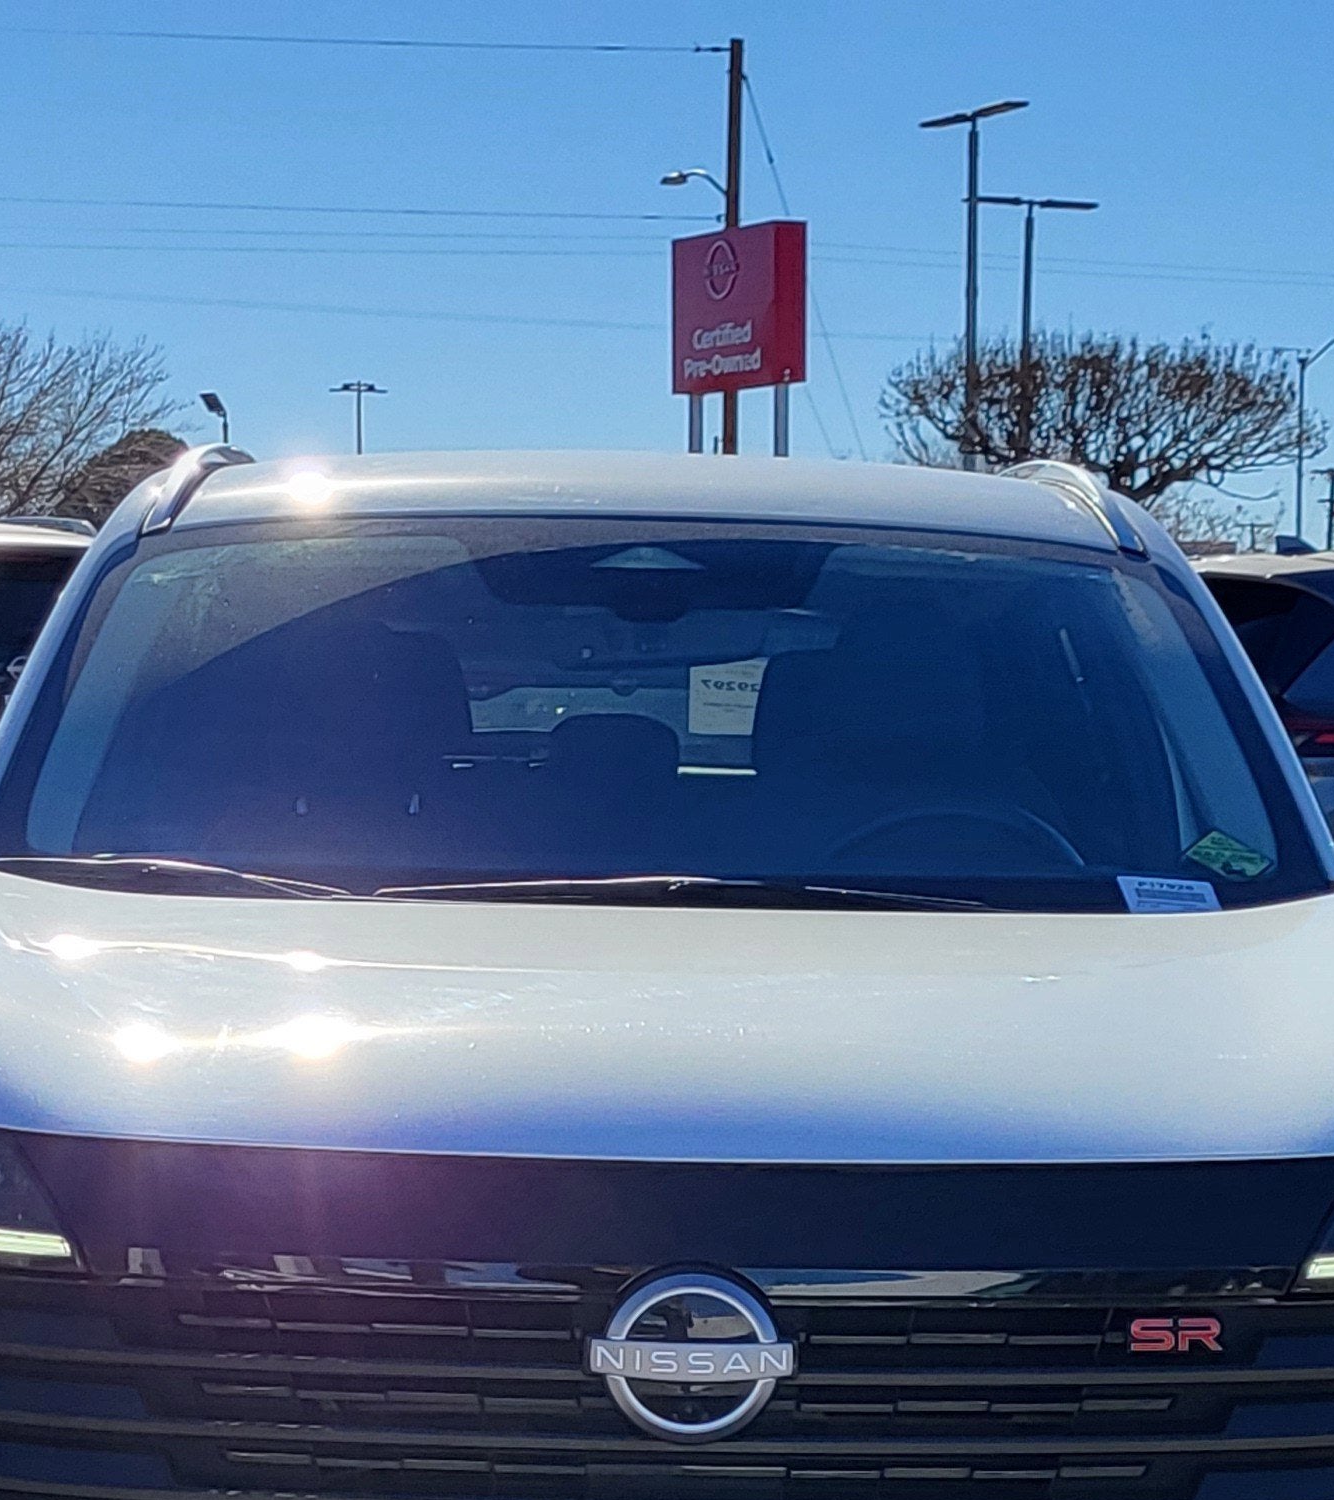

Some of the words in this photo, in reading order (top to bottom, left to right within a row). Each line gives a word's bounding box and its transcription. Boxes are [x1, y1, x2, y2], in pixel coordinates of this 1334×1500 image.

[693, 319, 752, 350] Certified
[684, 347, 762, 379] Pre-Owned
[1130, 1318, 1223, 1351] SR
[596, 1345, 787, 1374] NISSAN
